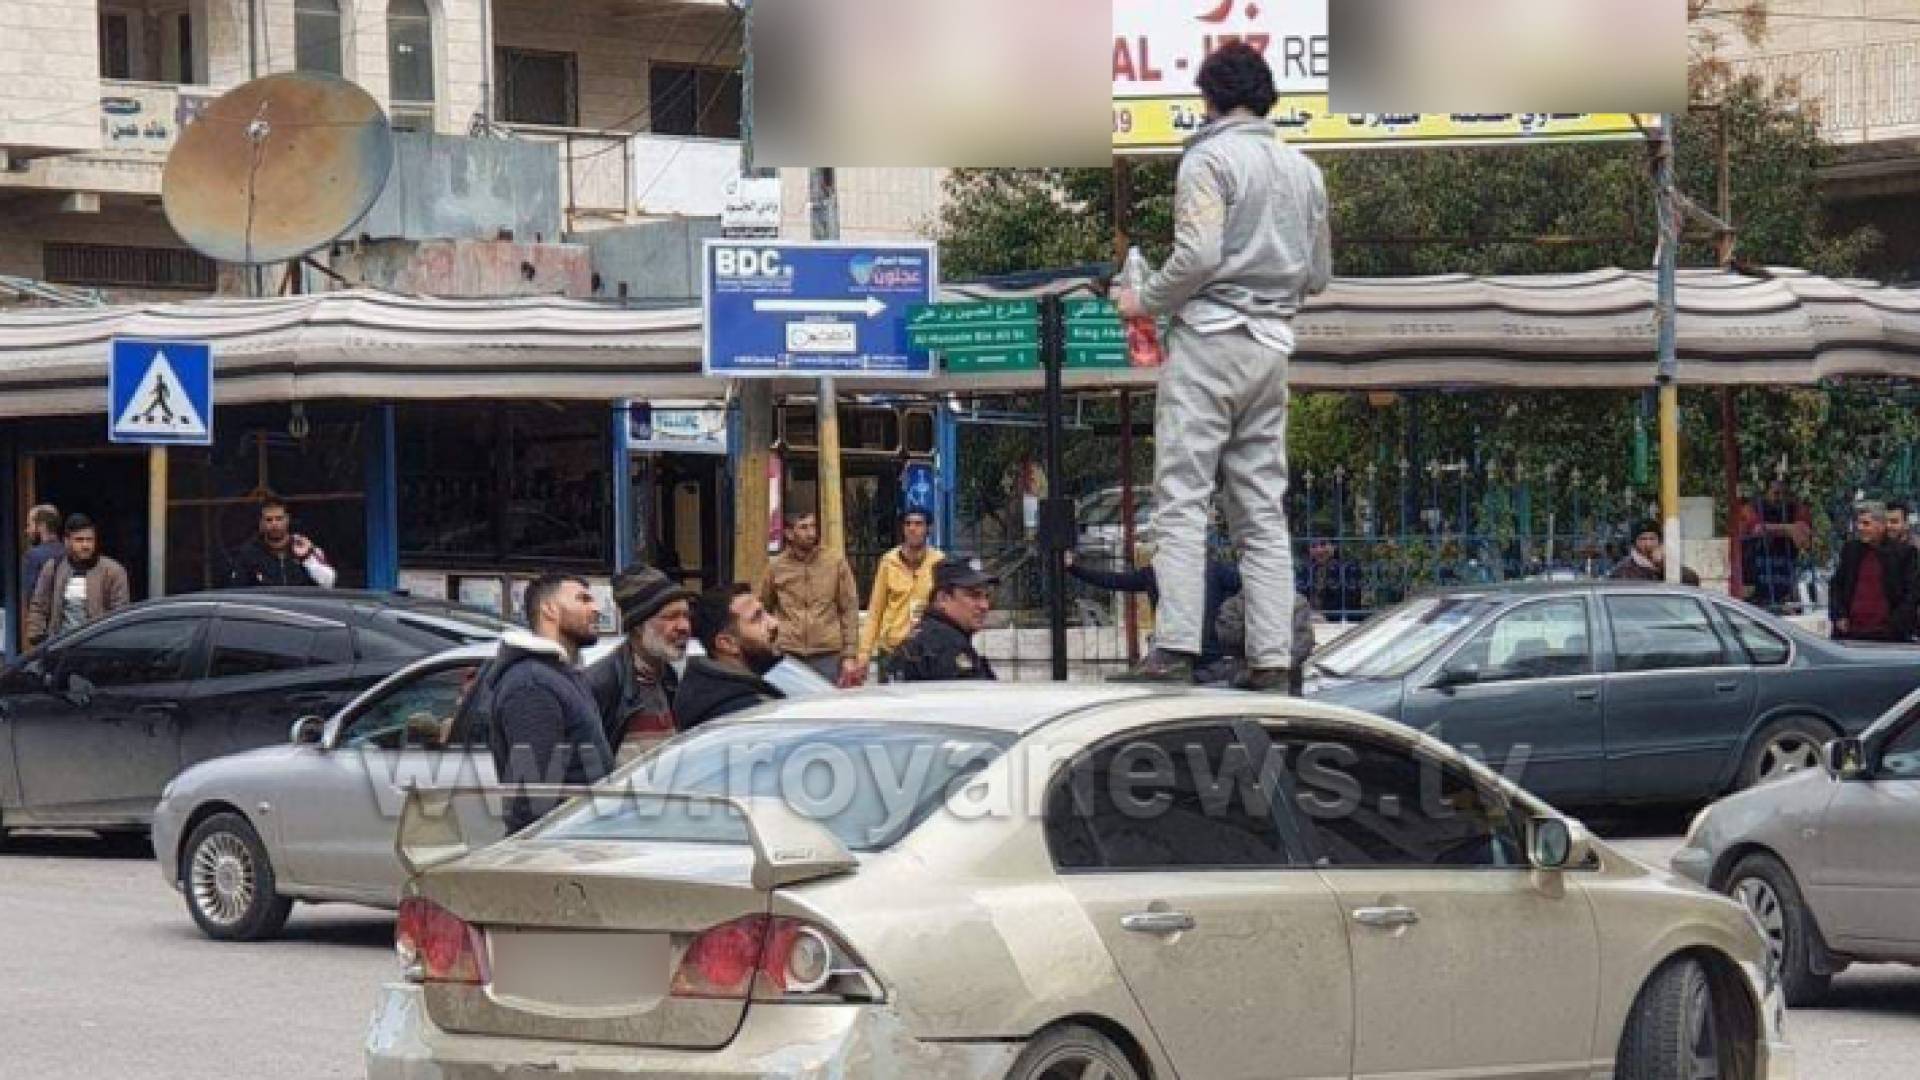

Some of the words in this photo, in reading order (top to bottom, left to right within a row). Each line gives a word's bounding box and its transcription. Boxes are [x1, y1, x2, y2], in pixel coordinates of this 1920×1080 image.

[1112, 35, 1161, 81] AL
[1283, 35, 1328, 77] RE
[940, 310, 952, 321] بن
[955, 304, 992, 320] الحسين
[995, 301, 1027, 320] شارع
[1073, 327, 1099, 341] King
